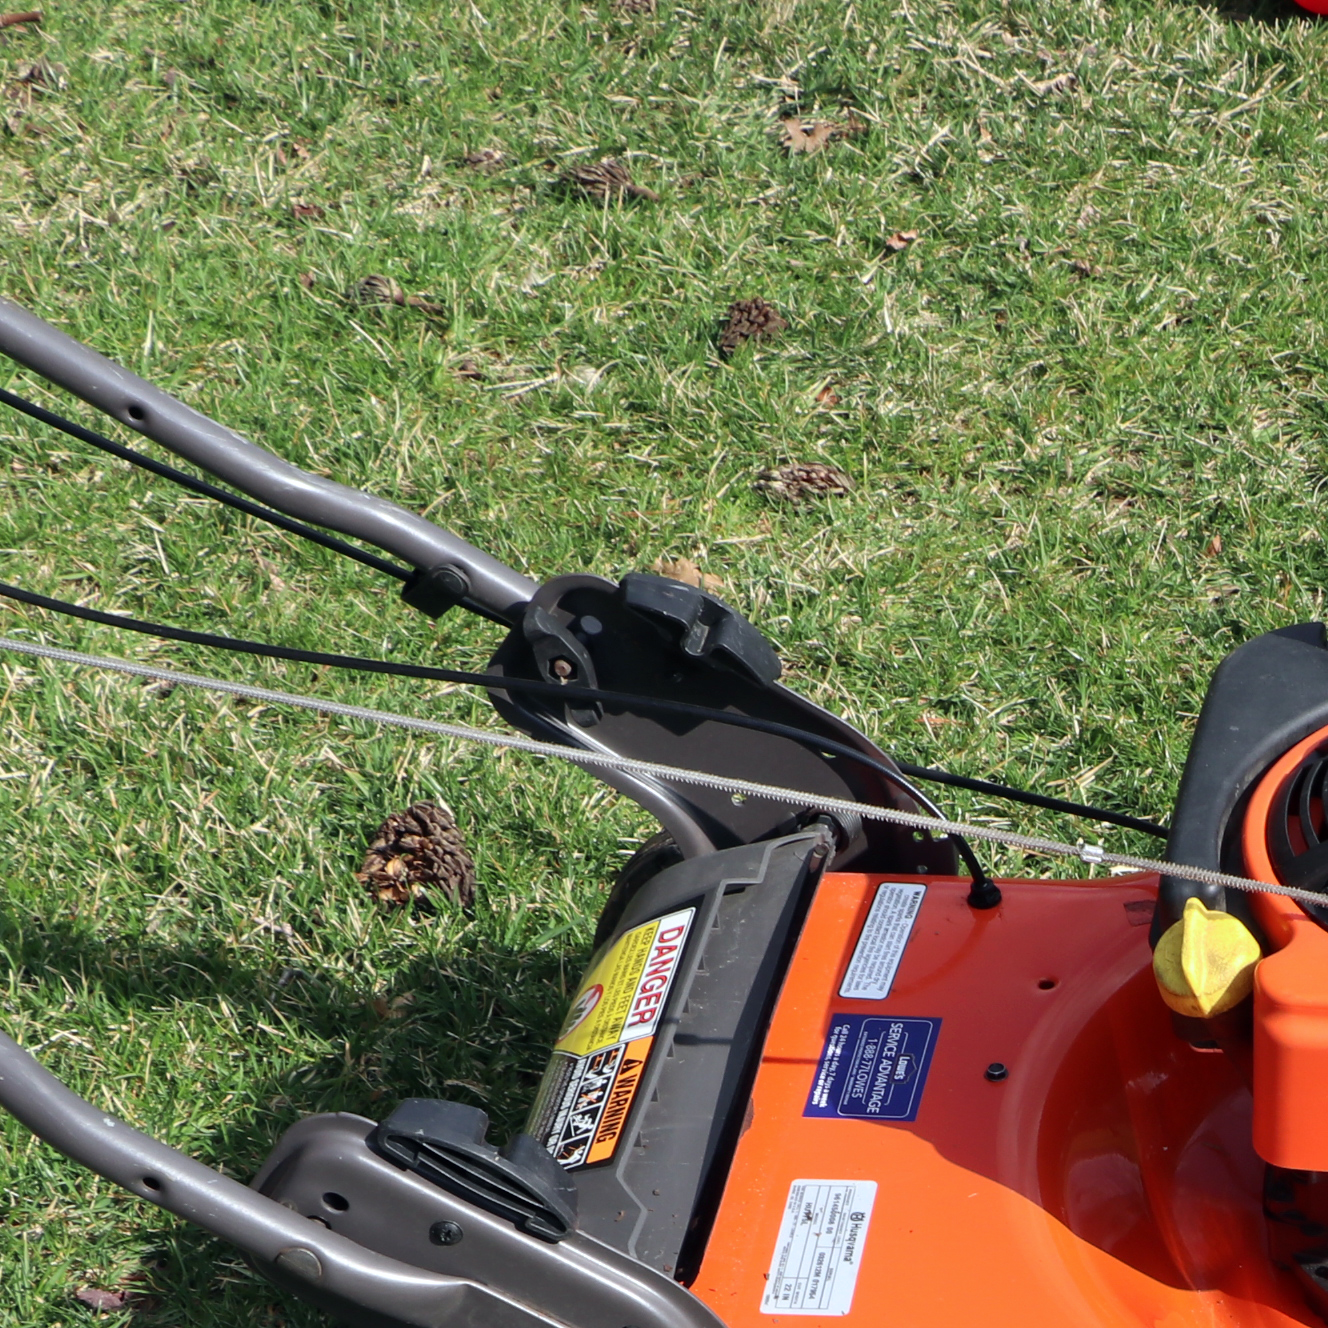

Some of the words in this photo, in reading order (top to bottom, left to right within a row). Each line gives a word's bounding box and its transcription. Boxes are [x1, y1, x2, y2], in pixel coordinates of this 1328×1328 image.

[903, 890, 921, 919] WARNING
[641, 925, 655, 945] KEEP
[629, 946, 648, 975] HANDS
[624, 976, 637, 993] AND
[626, 924, 685, 1027] DANGER
[615, 994, 631, 1014] FEET
[605, 1015, 623, 1040] AWAY
[832, 1026, 842, 1034] for
[840, 1024, 850, 1034] Call
[833, 1041, 845, 1056] hours
[881, 1022, 903, 1057] SERVICE
[819, 1060, 830, 1079] service
[823, 1076, 834, 1088] days
[865, 1058, 893, 1113] ADVANTAGE
[809, 1085, 823, 1104] repairs
[818, 1093, 830, 1107] week
[595, 1073, 637, 1143] WARNING
[841, 1223, 861, 1262] Husqvarna
[783, 1283, 792, 1291] 22
